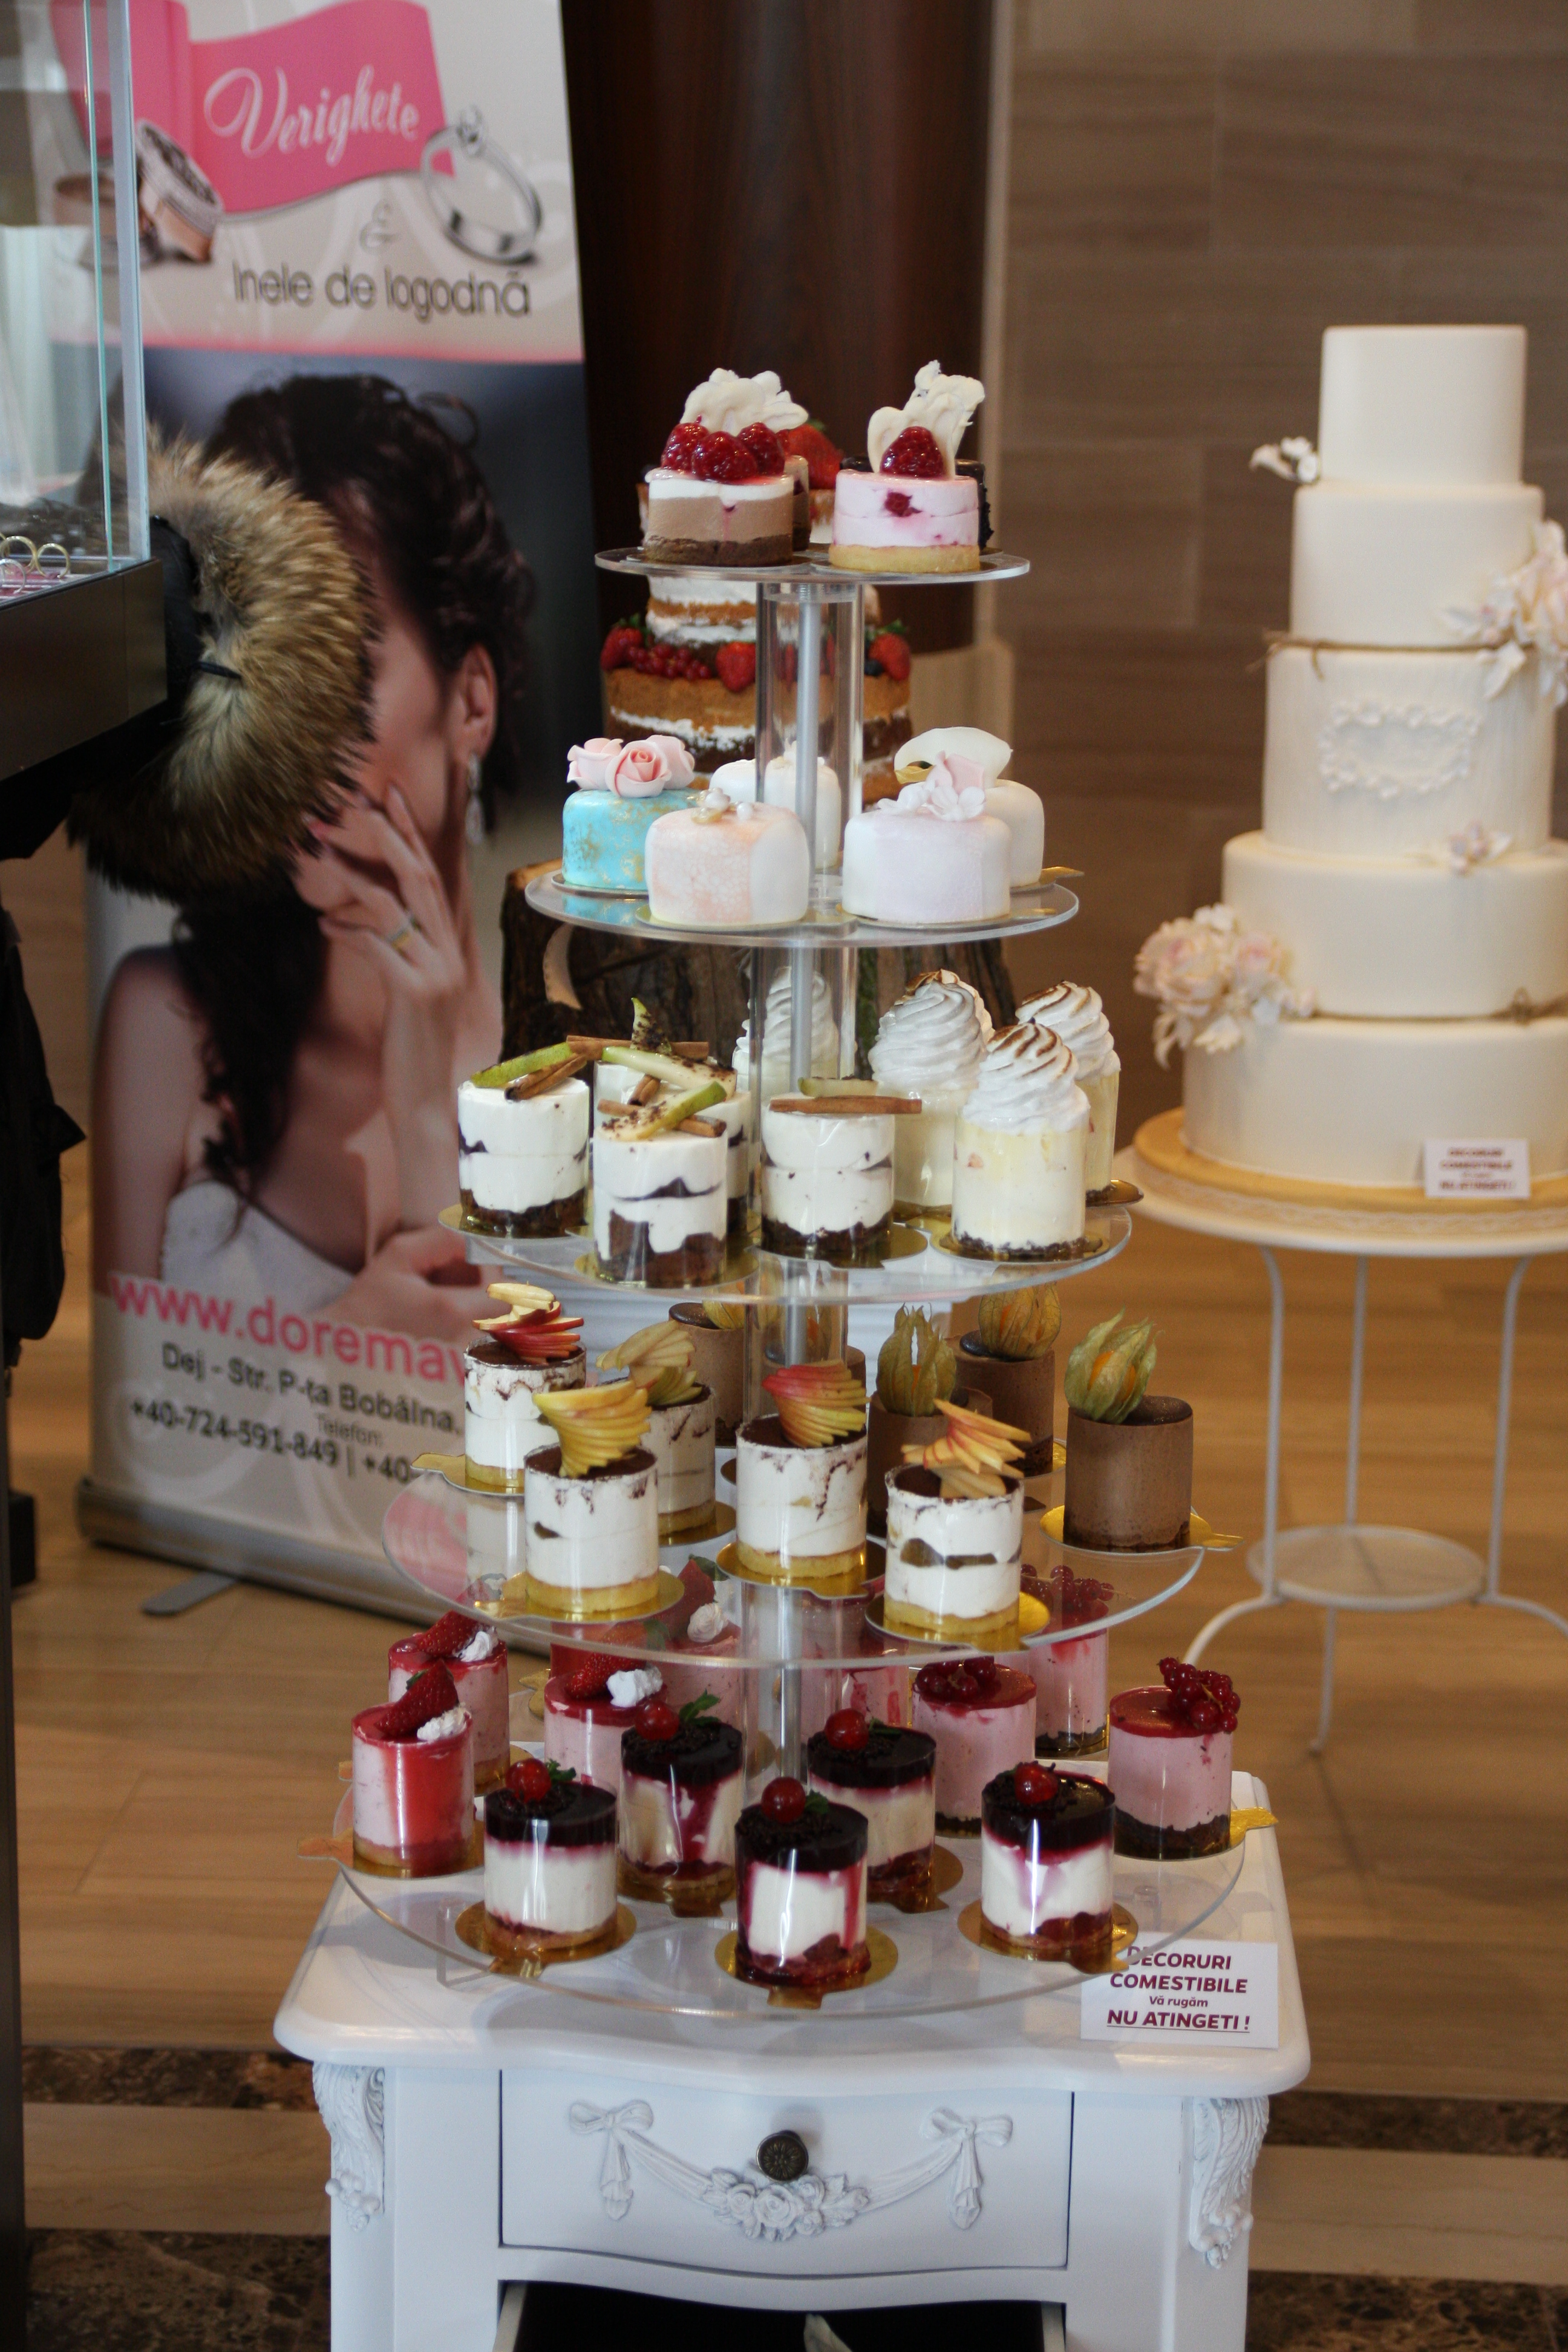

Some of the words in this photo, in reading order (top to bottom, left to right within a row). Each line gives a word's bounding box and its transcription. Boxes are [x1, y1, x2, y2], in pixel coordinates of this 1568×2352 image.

[203, 64, 419, 167] Verighete
[233, 260, 313, 307] Inele
[325, 263, 376, 309] de
[162, 1341, 206, 1382] Dej
[1126, 1945, 1232, 1970] DECORURI
[1110, 1973, 1248, 1993] COMESTIBILE
[1149, 1995, 1165, 2005] Vă
[1168, 1996, 1208, 2008] rugăm
[1107, 2010, 1138, 2025] NU
